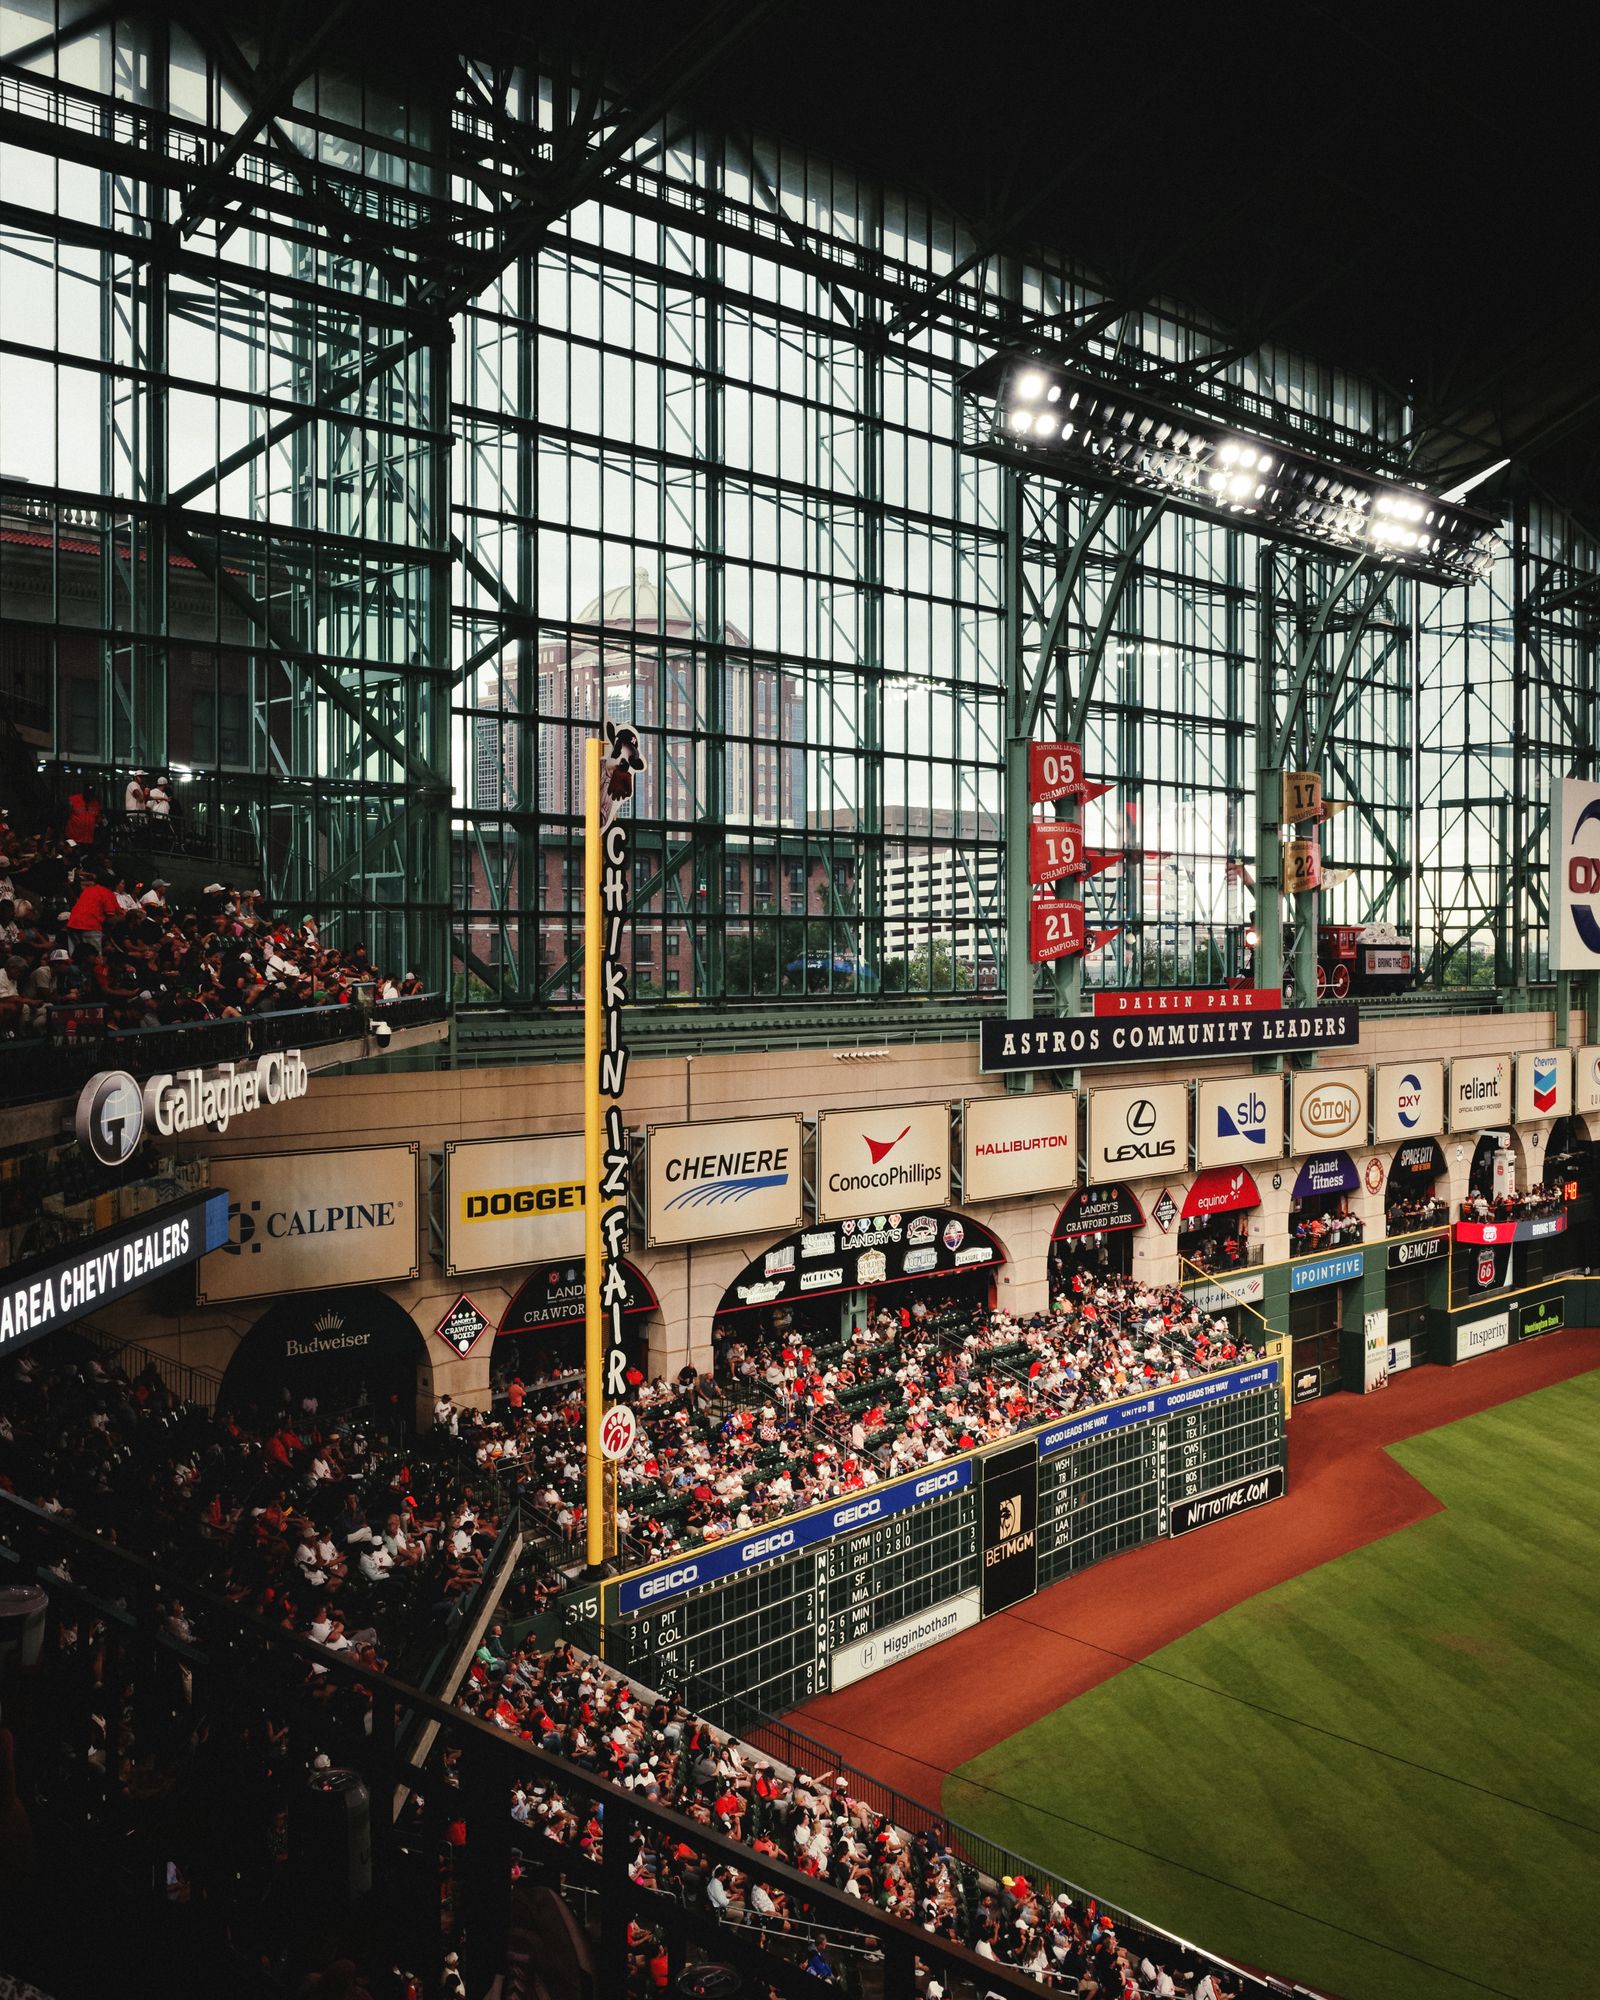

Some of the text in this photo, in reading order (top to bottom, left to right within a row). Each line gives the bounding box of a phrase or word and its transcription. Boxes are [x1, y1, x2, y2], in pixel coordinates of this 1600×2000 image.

[1043, 755, 1075, 785] 05
[1039, 783, 1084, 802] CHAMPIONS
[1293, 783, 1315, 809] 17
[1045, 837, 1075, 865] 19
[1040, 862, 1083, 880] CHAMPIONS
[1294, 855, 1315, 878] 22
[1045, 913, 1073, 941] 21
[1038, 939, 1080, 958] CHAMPIONS
[1119, 994, 1253, 1010] DAIKIN PARK
[1003, 1016, 1346, 1056] ASTROS COMMUNITY LEADERS
[1533, 1056, 1557, 1067] Chevron
[153, 1048, 308, 1136] Gallagher Club
[1398, 1094, 1421, 1108] OXY
[1460, 1077, 1498, 1101] reliant
[1237, 1092, 1266, 1125] slb
[1309, 1098, 1351, 1126] COTTON
[976, 1135, 1068, 1156] HALLIBURTON
[1104, 1140, 1176, 1163] LEXUS
[666, 1148, 788, 1182] CHENIERE
[1308, 1158, 1339, 1179] planet
[829, 1163, 942, 1192] ConocoPhillips
[1312, 1174, 1344, 1190] fitness
[467, 1184, 605, 1218] DOGGET
[1080, 1201, 1119, 1216] LANDRY'S
[1198, 1194, 1229, 1210] equinor
[267, 1201, 395, 1238] CALPINE
[1066, 1218, 1107, 1232] CRAWFORD
[1110, 1214, 1132, 1225] BOXES
[842, 1228, 902, 1250] LANDRY'S
[1408, 1239, 1440, 1260] EMCJET
[956, 1251, 992, 1264] PLEASURE PIER
[0, 1218, 189, 1343] AREA CHEVY DEALERS
[1296, 1259, 1360, 1285] 1POINTFIVE
[1481, 1264, 1492, 1278] 66
[524, 1304, 585, 1323] CRAWFOR
[445, 1323, 483, 1335] CRAWFORD
[453, 1331, 475, 1340] BOXES
[1469, 1322, 1507, 1346] Insperity
[286, 1332, 370, 1357] Budweiser
[1368, 1336, 1385, 1351] WM
[1240, 1373, 1262, 1384] UNITED
[1167, 1381, 1229, 1406] GOOD LEADS THE WAY
[1121, 1405, 1147, 1418] UNITED
[1187, 1390, 1278, 1427] SD 6
[1045, 1415, 1109, 1446] GOOD LEADS THE WAY
[1186, 1403, 1278, 1440] TEX F 4
[1055, 1457, 1070, 1471] WSH
[1151, 1428, 1156, 1436] 4
[1184, 1443, 1199, 1455] CWS
[1186, 1429, 1278, 1468] DET F 4
[1059, 1441, 1156, 1483] TB F 3
[915, 1470, 958, 1497] GEICO
[1186, 1471, 1197, 1483] BOS
[1055, 1470, 1156, 1516] NYY F 2
[1057, 1488, 1067, 1501] CIN
[1186, 1484, 1198, 1496] SEA
[1186, 1478, 1269, 1526] NITTOTIRE.COM
[834, 1498, 880, 1527] GEICO
[1055, 1520, 1069, 1532] LAA
[742, 1529, 794, 1561] GEICO
[850, 1535, 870, 1553] NYM
[875, 1531, 881, 1542] 0
[885, 1527, 891, 1538] 0
[895, 1524, 901, 1535] 0
[986, 1532, 1034, 1568] BETMGM
[1055, 1532, 1069, 1546] ATH
[853, 1535, 911, 1568] PHI 1 2 8 0
[855, 1527, 975, 1585] SF 3
[633, 1547, 804, 1619] P 1 2 3 4 5 6 7 8 9 R
[639, 1565, 698, 1600] GEICO
[852, 1541, 975, 1603] MIA F 6
[807, 1594, 813, 1607] 3
[661, 1610, 677, 1628] PIT
[818, 1556, 826, 1687] NATIONAL
[852, 1605, 870, 1623] MIN
[658, 1627, 682, 1647] COL
[689, 1611, 813, 1673] F 4
[853, 1622, 868, 1638] ARI
[883, 1611, 957, 1655] Higginbotham
[807, 1665, 813, 1679] 8
[807, 1681, 813, 1695] 6
